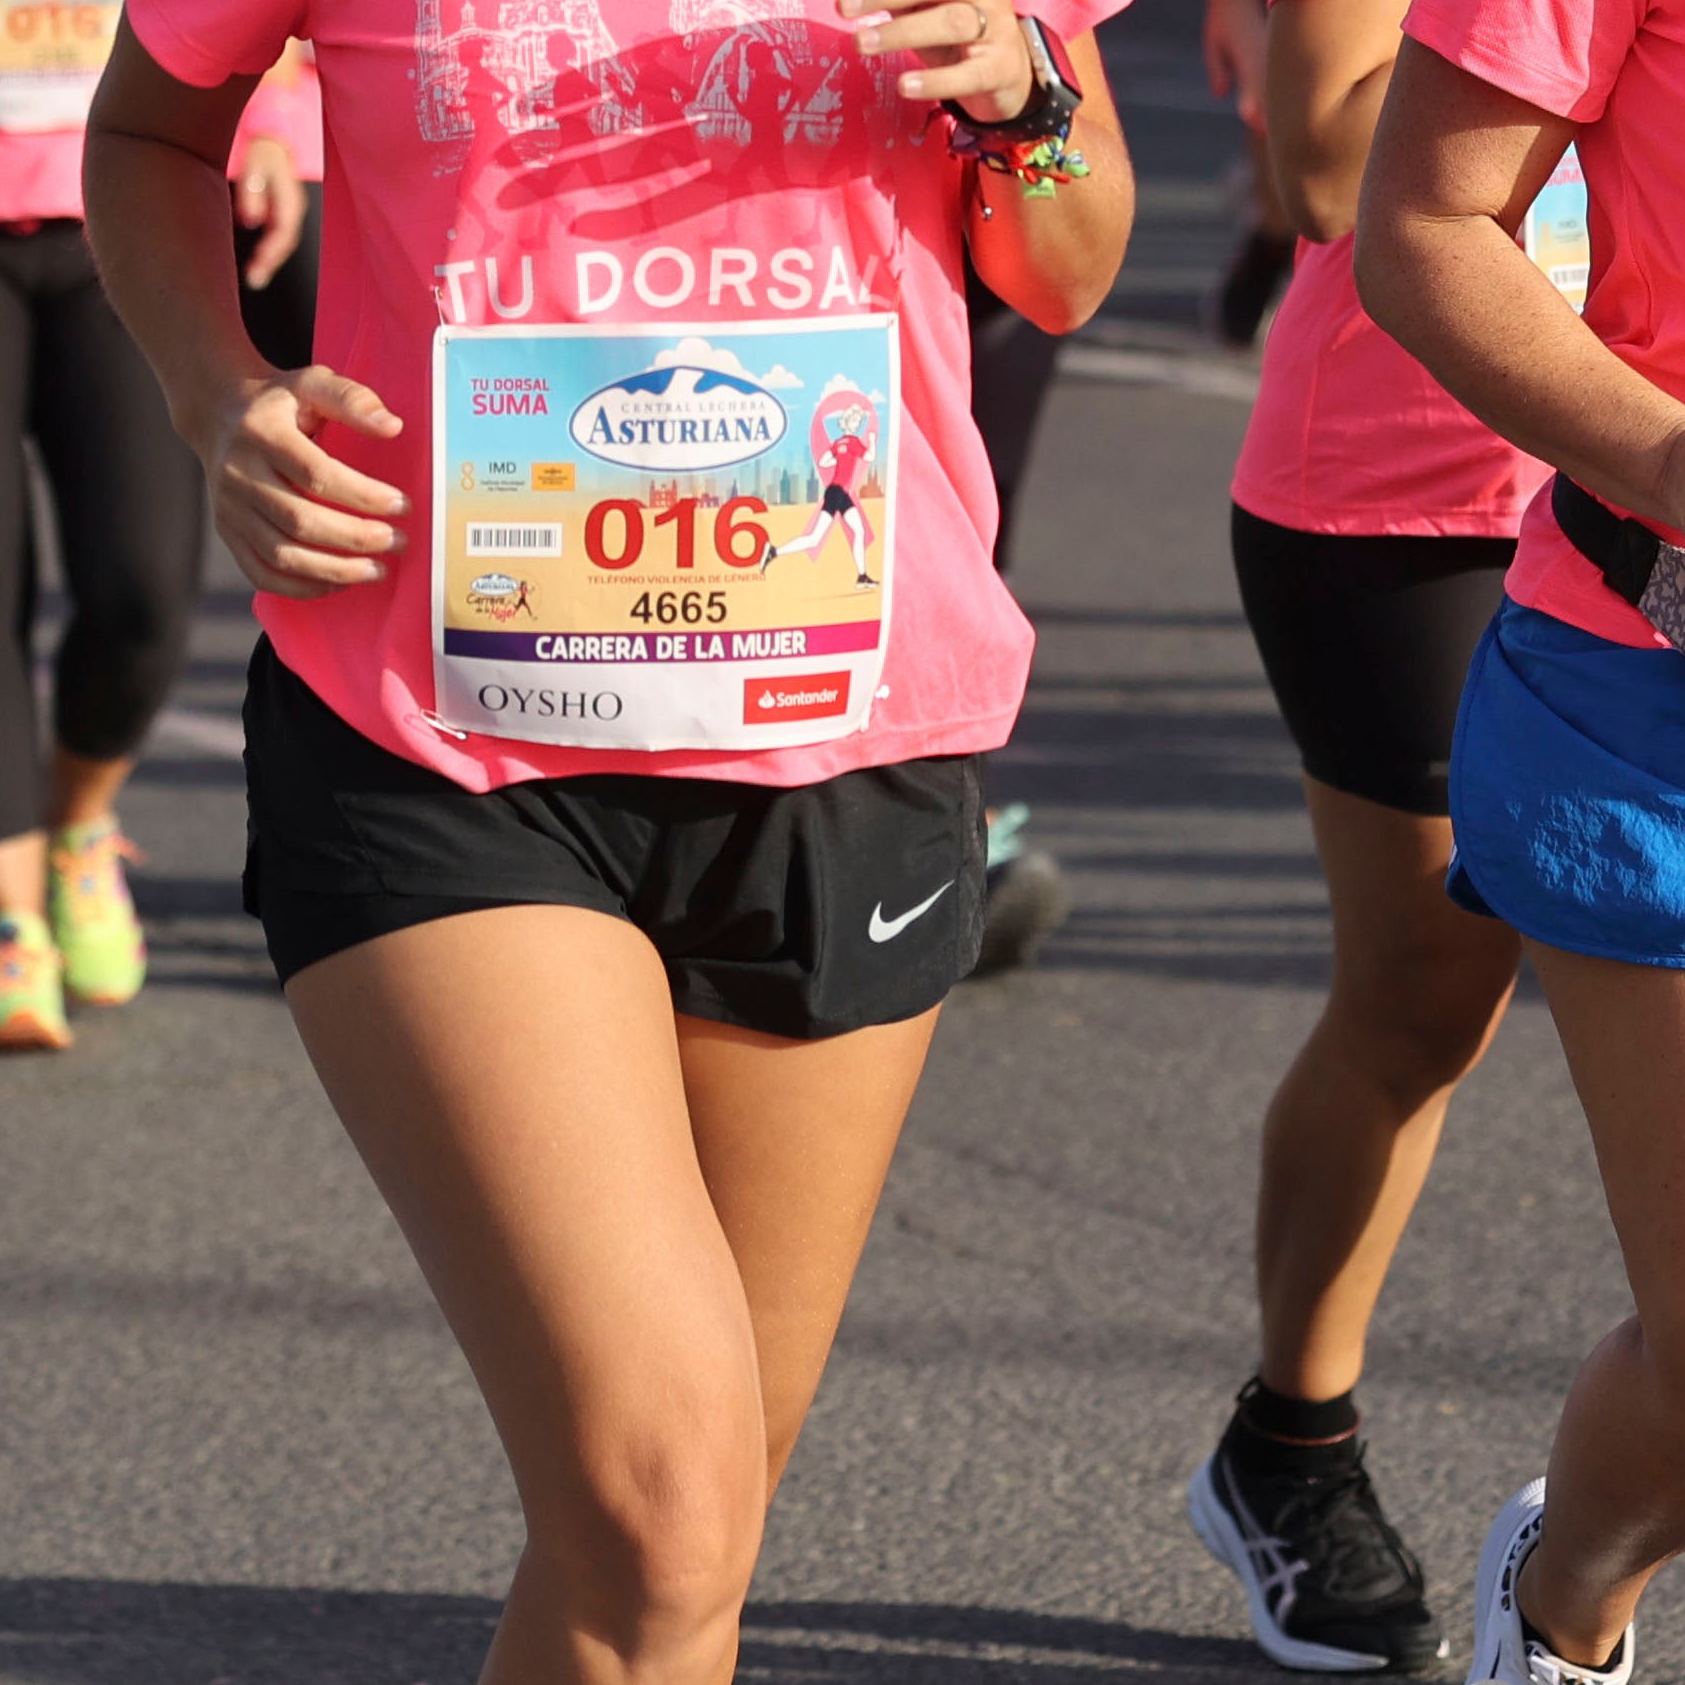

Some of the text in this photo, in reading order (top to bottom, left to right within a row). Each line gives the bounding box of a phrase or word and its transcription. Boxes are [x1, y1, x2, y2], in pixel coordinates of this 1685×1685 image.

[434, 245, 894, 323] TU DORSAL
[471, 378, 550, 392] TU DORSAL
[472, 393, 549, 415] SUMA
[620, 400, 766, 414] CENTRAL LECHERA
[586, 405, 772, 445] ASTURIANA
[488, 462, 517, 474] IMD
[583, 495, 772, 570] 016
[647, 575, 706, 585] VIOLENCIA
[708, 574, 722, 584] DE
[630, 593, 728, 625] 4665
[535, 630, 807, 661] CARRERA DE LA MUJER
[478, 683, 624, 722] OYSHO
[776, 687, 839, 708] Santander
